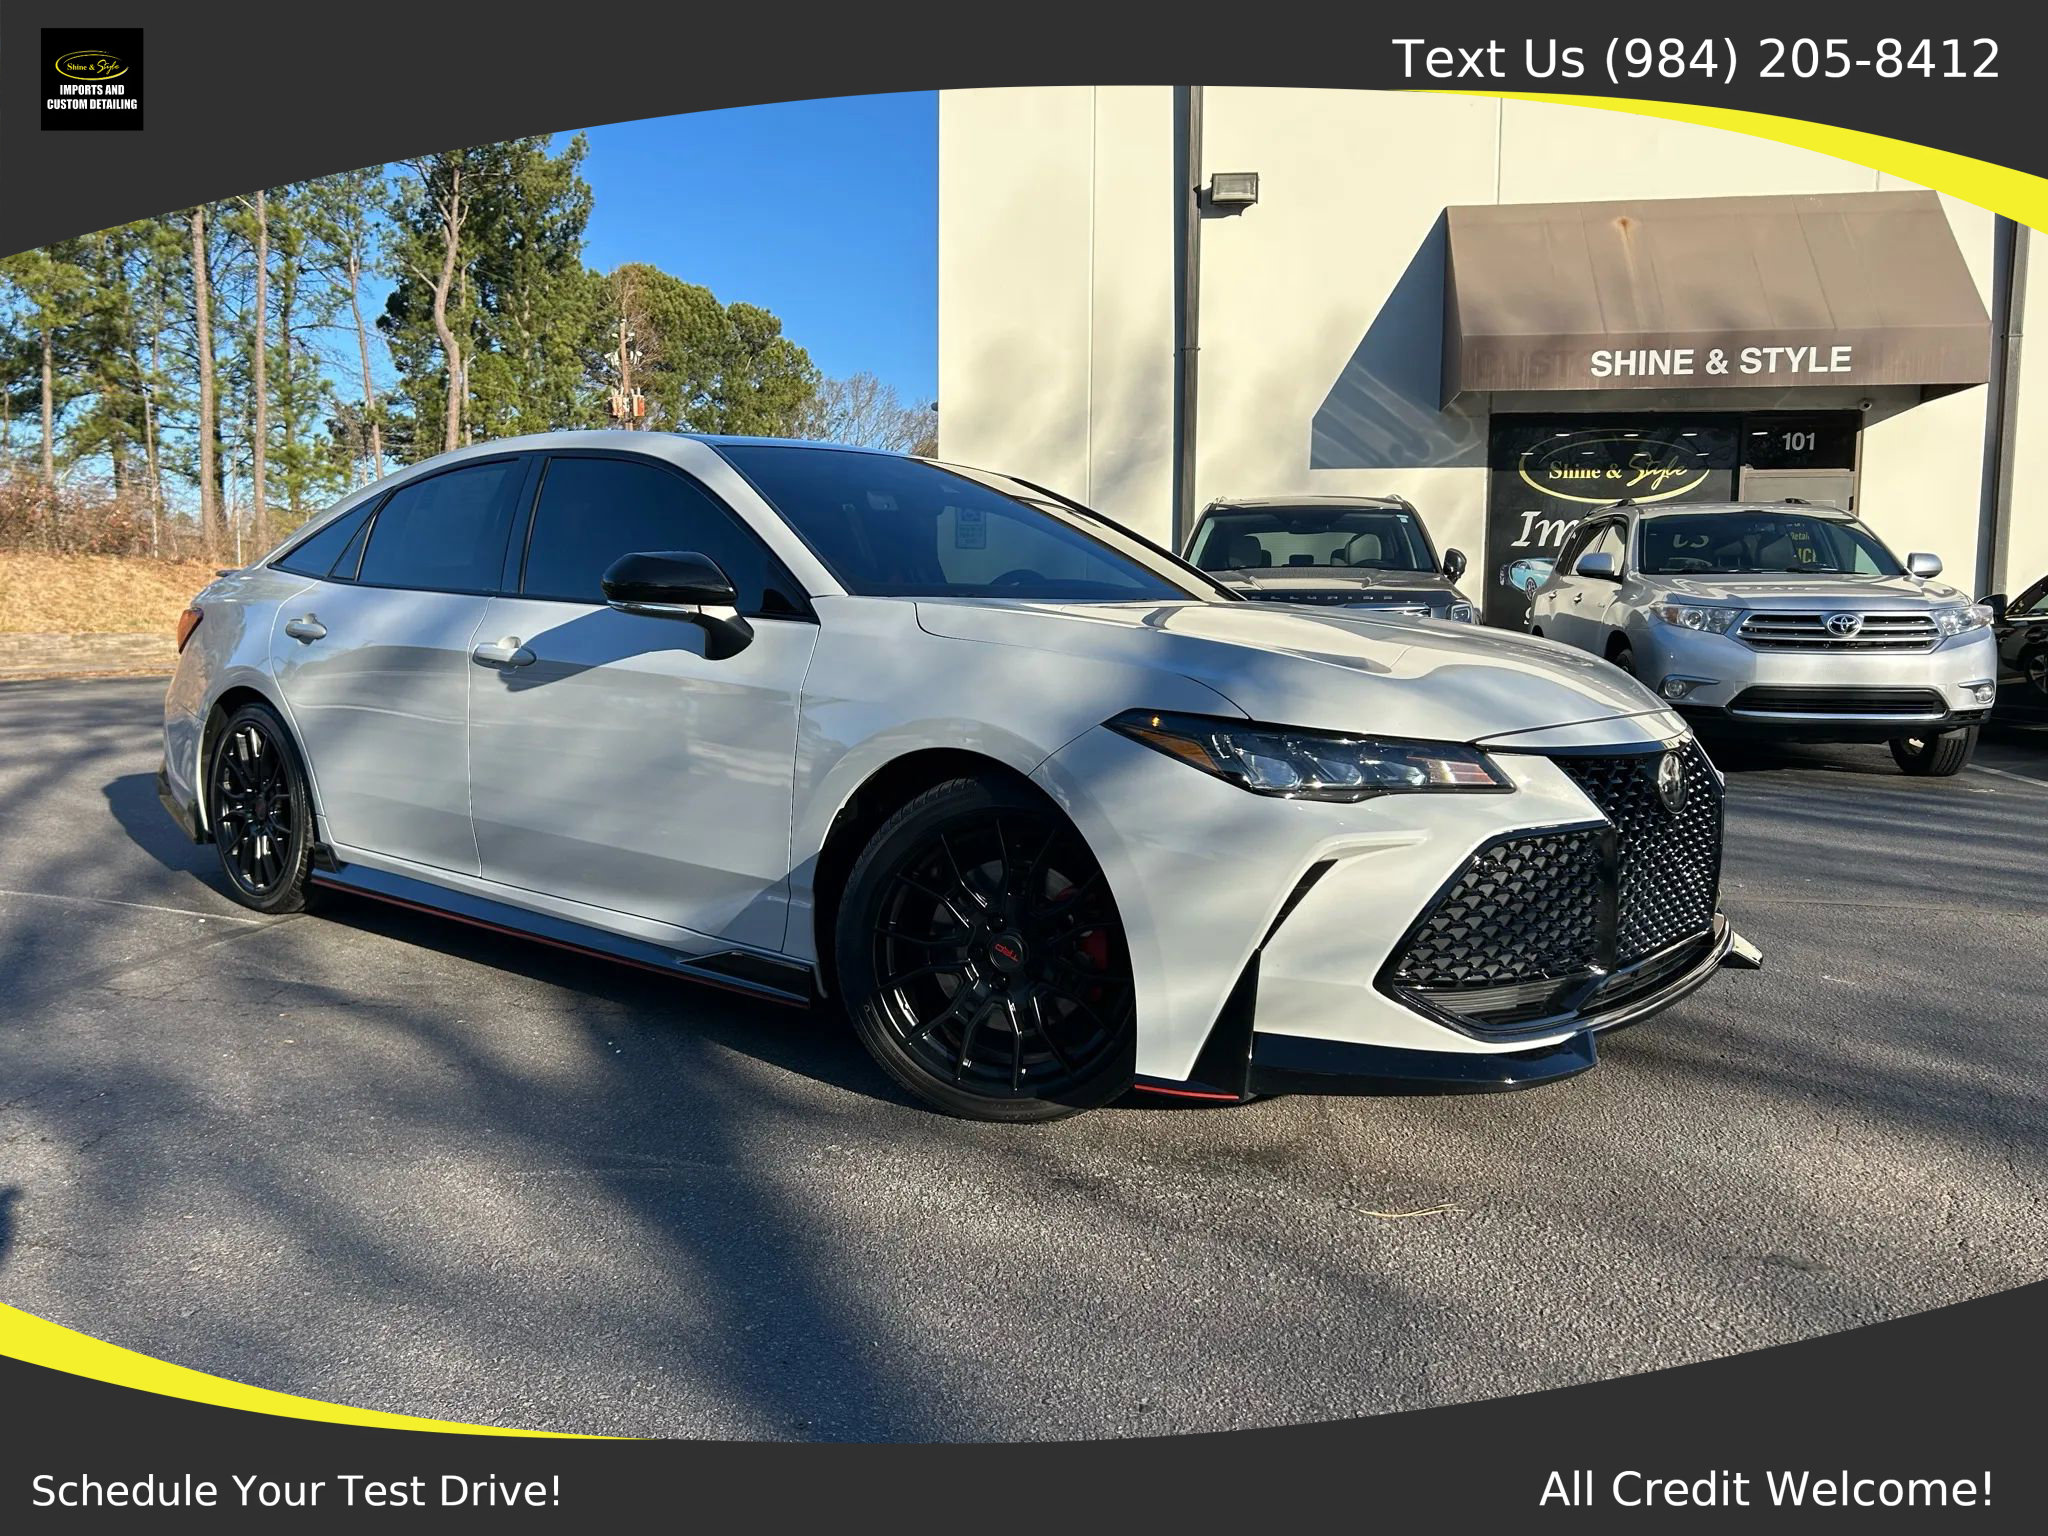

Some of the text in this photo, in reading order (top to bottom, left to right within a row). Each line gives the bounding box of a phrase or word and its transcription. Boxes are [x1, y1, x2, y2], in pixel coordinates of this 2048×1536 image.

[1590, 346, 1852, 377] SHINE & STYLE
[1782, 432, 1816, 451] 101
[1549, 451, 1688, 490] Shine & Style
